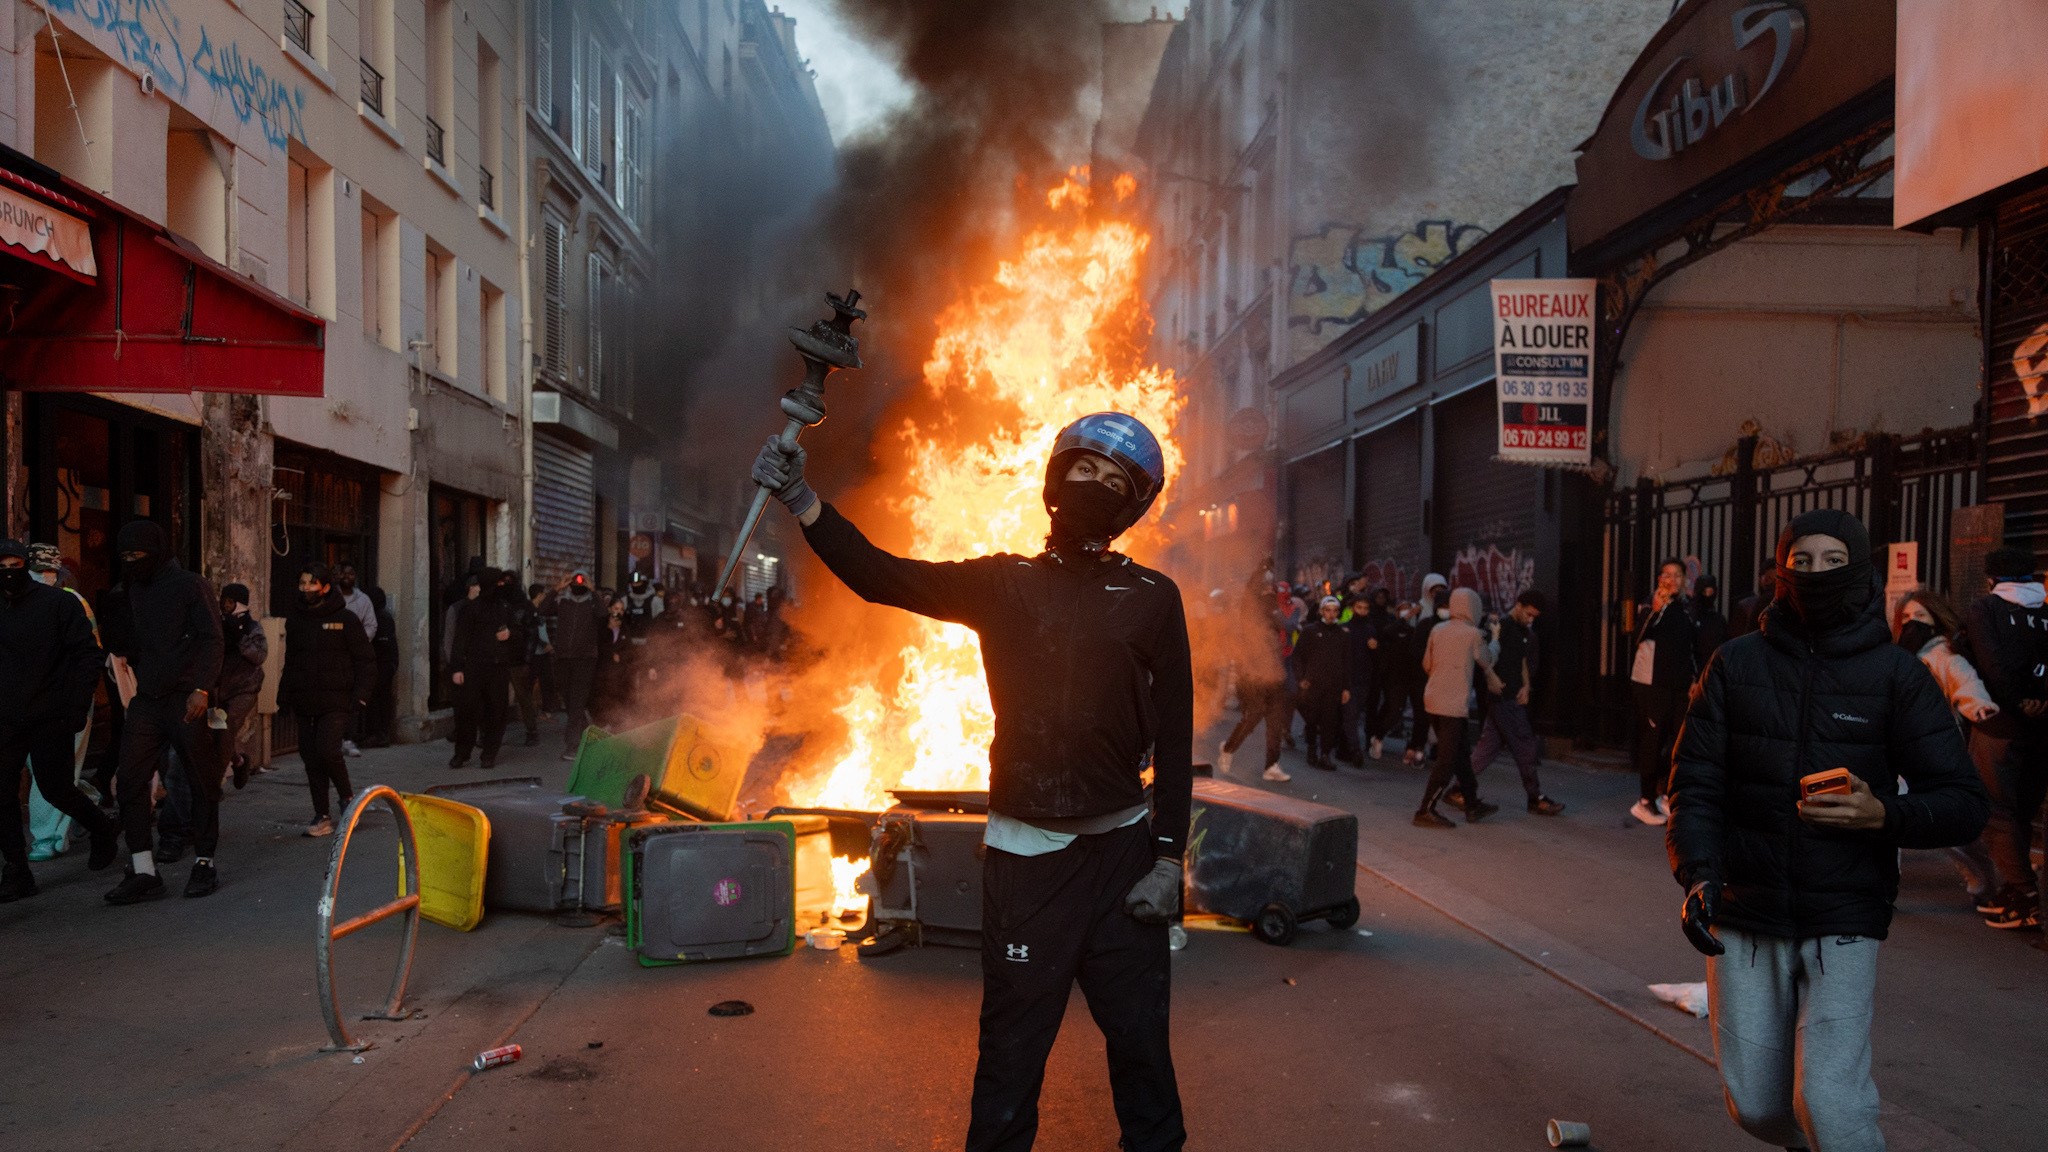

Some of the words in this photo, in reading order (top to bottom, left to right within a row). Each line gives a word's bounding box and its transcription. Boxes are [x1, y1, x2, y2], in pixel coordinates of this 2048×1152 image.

[1498, 294, 1588, 318] BUREAUX
[1501, 319, 1516, 348] À
[1522, 325, 1588, 349] LOUER
[1503, 381, 1518, 396] 06
[1521, 381, 1535, 396] 30
[1538, 381, 1553, 397] 32
[1557, 382, 1571, 397] 19
[1573, 382, 1588, 398] 35
[1539, 406, 1561, 422] JLL
[1097, 427, 1124, 443] cooltra
[1503, 429, 1519, 446] 06
[1520, 429, 1536, 446] 70
[1538, 430, 1553, 447] 24
[1555, 430, 1570, 447] 99
[1572, 430, 1587, 448] 12
